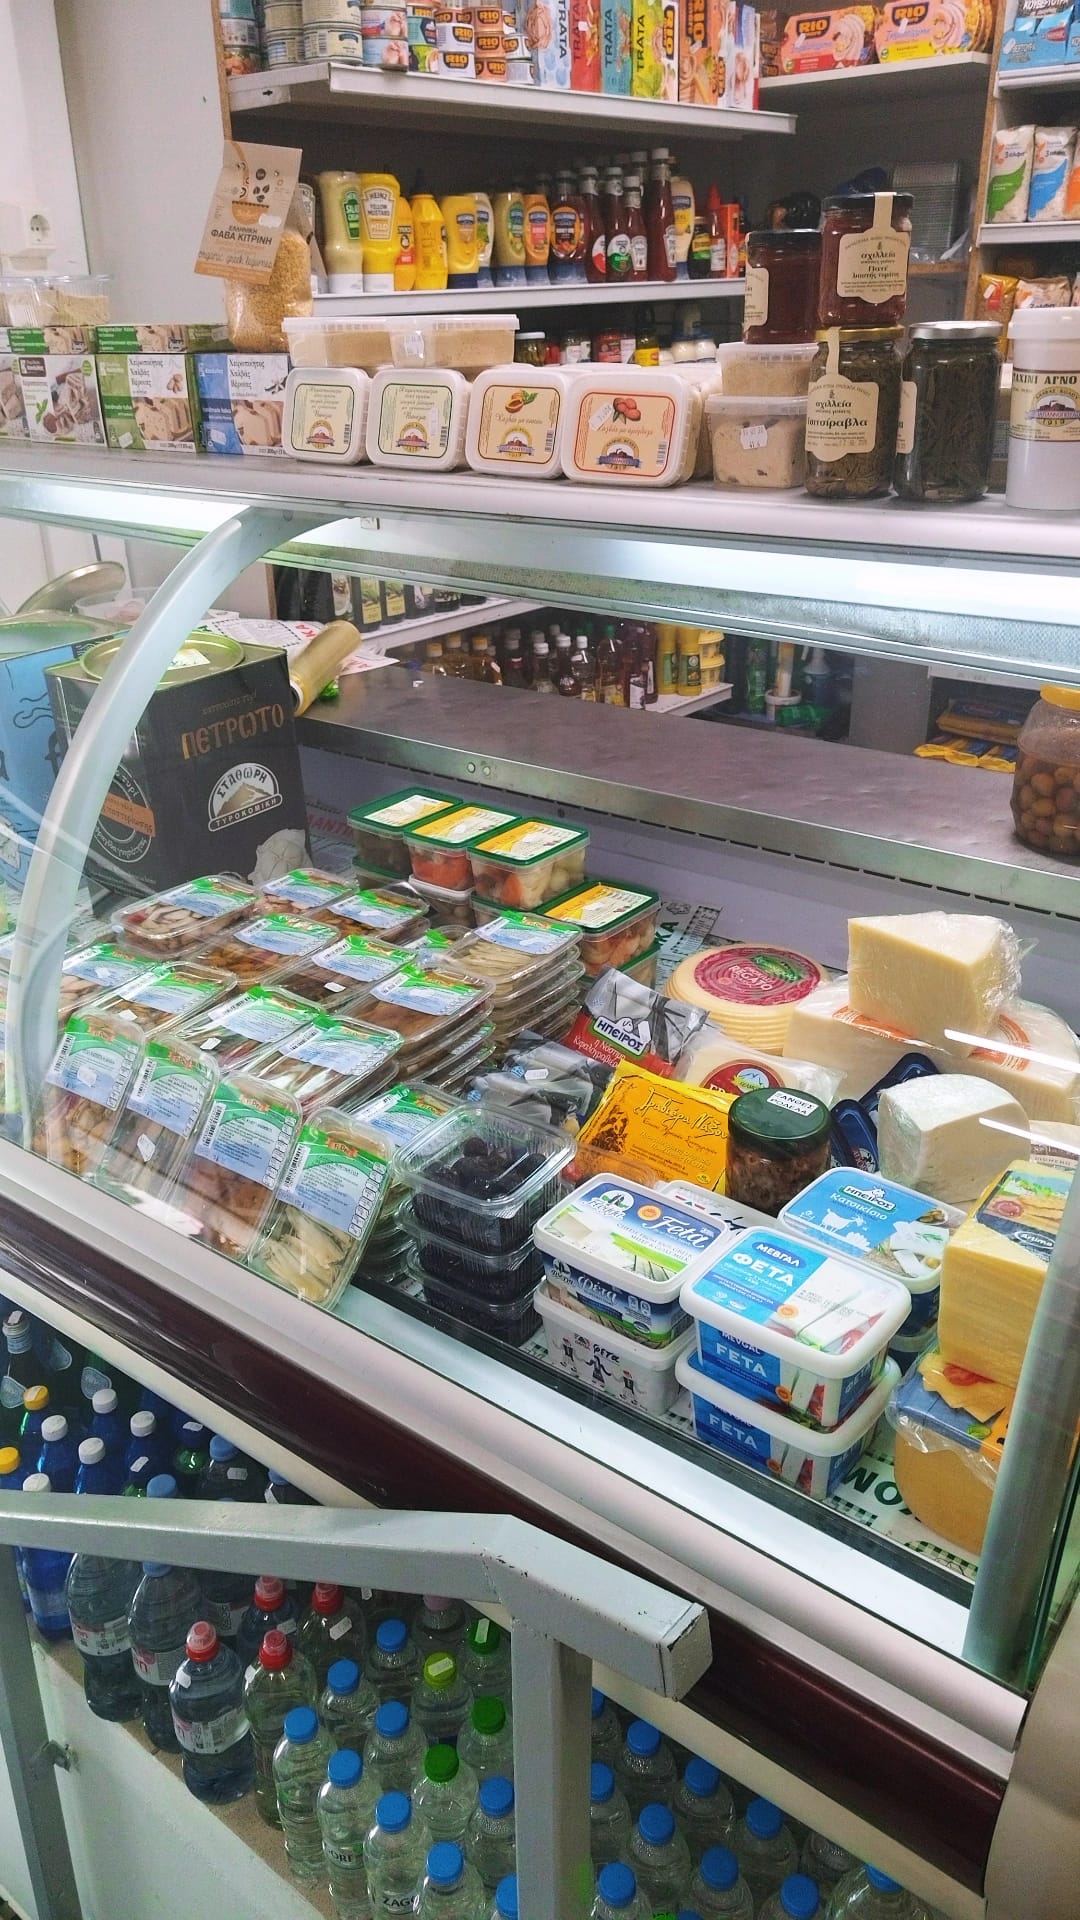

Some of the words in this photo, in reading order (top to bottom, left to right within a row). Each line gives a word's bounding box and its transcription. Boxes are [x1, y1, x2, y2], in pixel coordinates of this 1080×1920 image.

[479, 11, 499, 20] RIO
[799, 19, 828, 34] RIO
[894, 5, 926, 20] RIO
[479, 37, 499, 47] RIO
[604, 8, 613, 69] TRATA
[636, 14, 645, 73] TRATA
[445, 53, 468, 65] RIO
[369, 192, 388, 200] HEINZ
[211, 228, 236, 241] ΦΑΒΑ
[238, 233, 273, 246] ΚΙΤΡΙΝΗ
[181, 703, 285, 761] ΠΕΤΡΩΤΟ
[216, 766, 268, 798] ΣΤΑΘΩΡΗ
[215, 798, 277, 827] ΤΥΡΟΚΟΜΙΚΗ
[728, 964, 773, 992] REGATO
[597, 1020, 644, 1052] ΗΠΕΙΡΟΣ
[829, 1192, 888, 1221] Κατσικίσιο
[845, 1186, 893, 1209] ΗΠΕΙΡΟΣ
[642, 1215, 709, 1249] Feta
[732, 1252, 795, 1287] ΦΕΤΑ
[755, 1243, 801, 1268] ΜΕΒΓΑΛ
[716, 1342, 768, 1379] FETA
[709, 1413, 758, 1450] FETA
